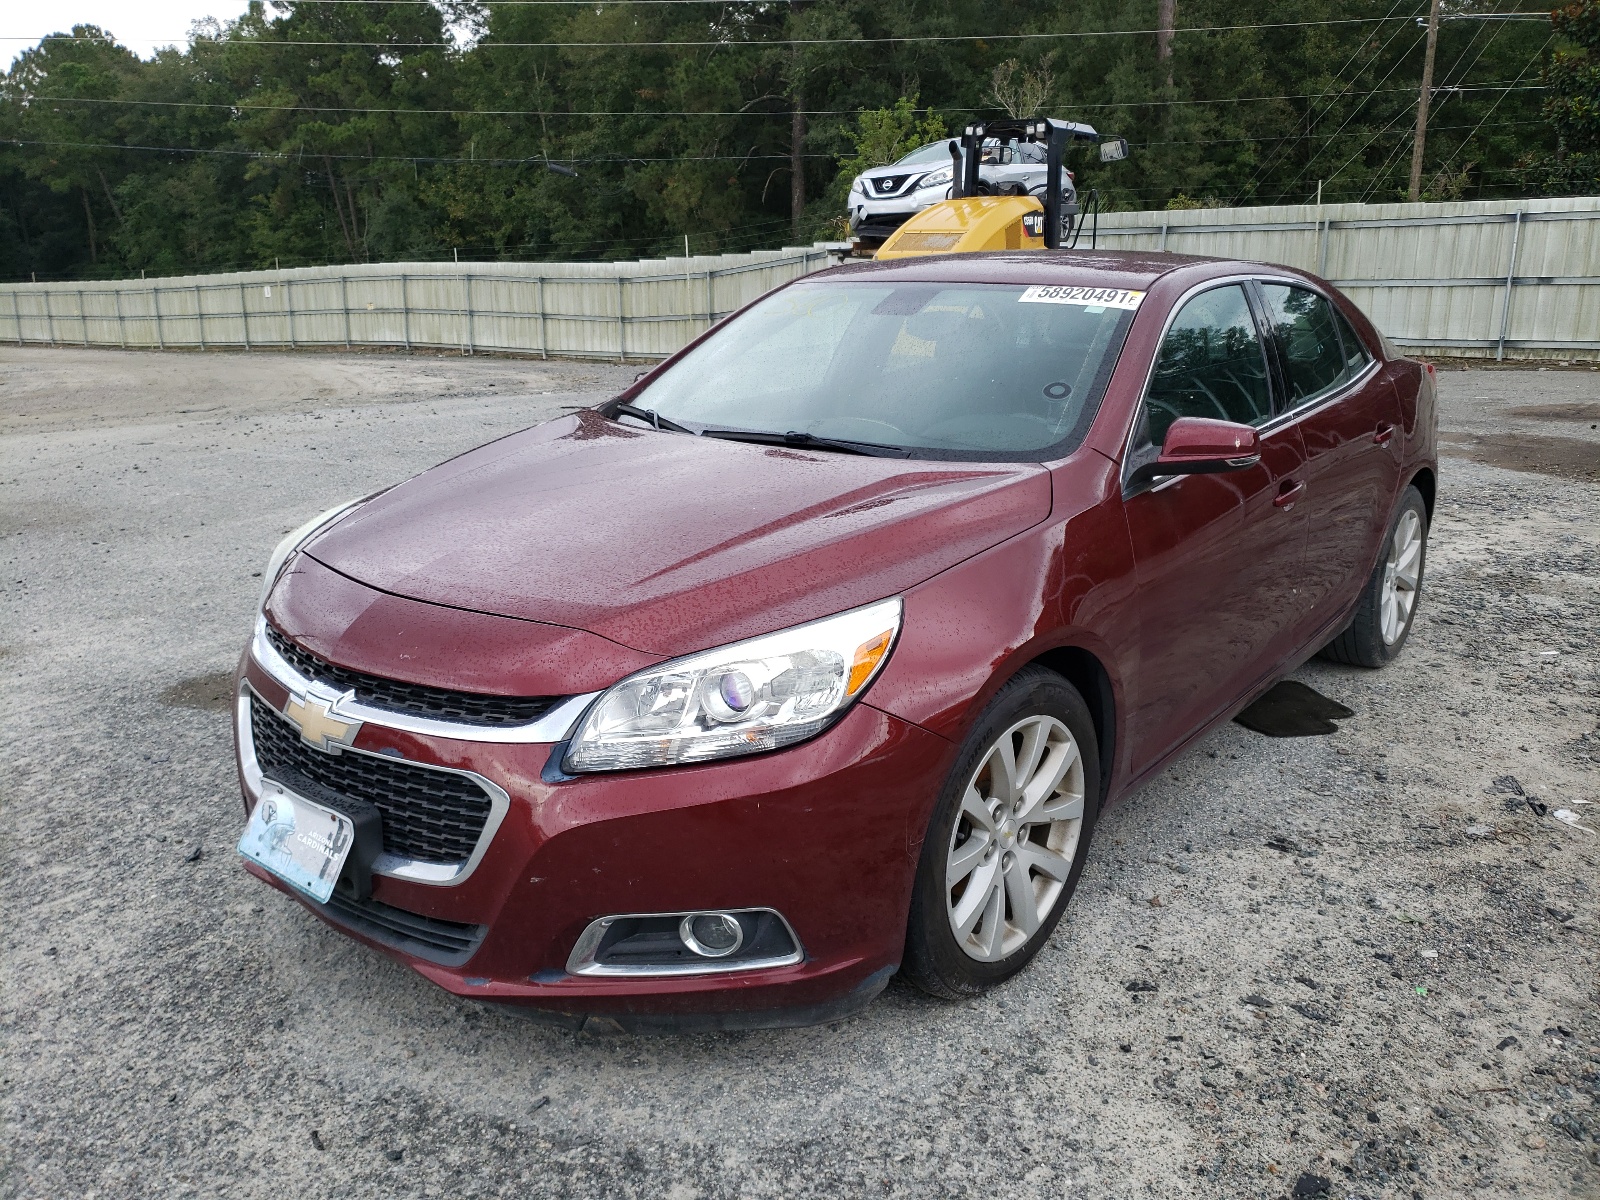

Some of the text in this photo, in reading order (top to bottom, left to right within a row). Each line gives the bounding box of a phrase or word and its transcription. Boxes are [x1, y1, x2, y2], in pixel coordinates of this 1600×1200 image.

[1037, 286, 1129, 304] 58920491
[297, 833, 340, 861] CARDINALS
[308, 830, 333, 847] ARIZONA
